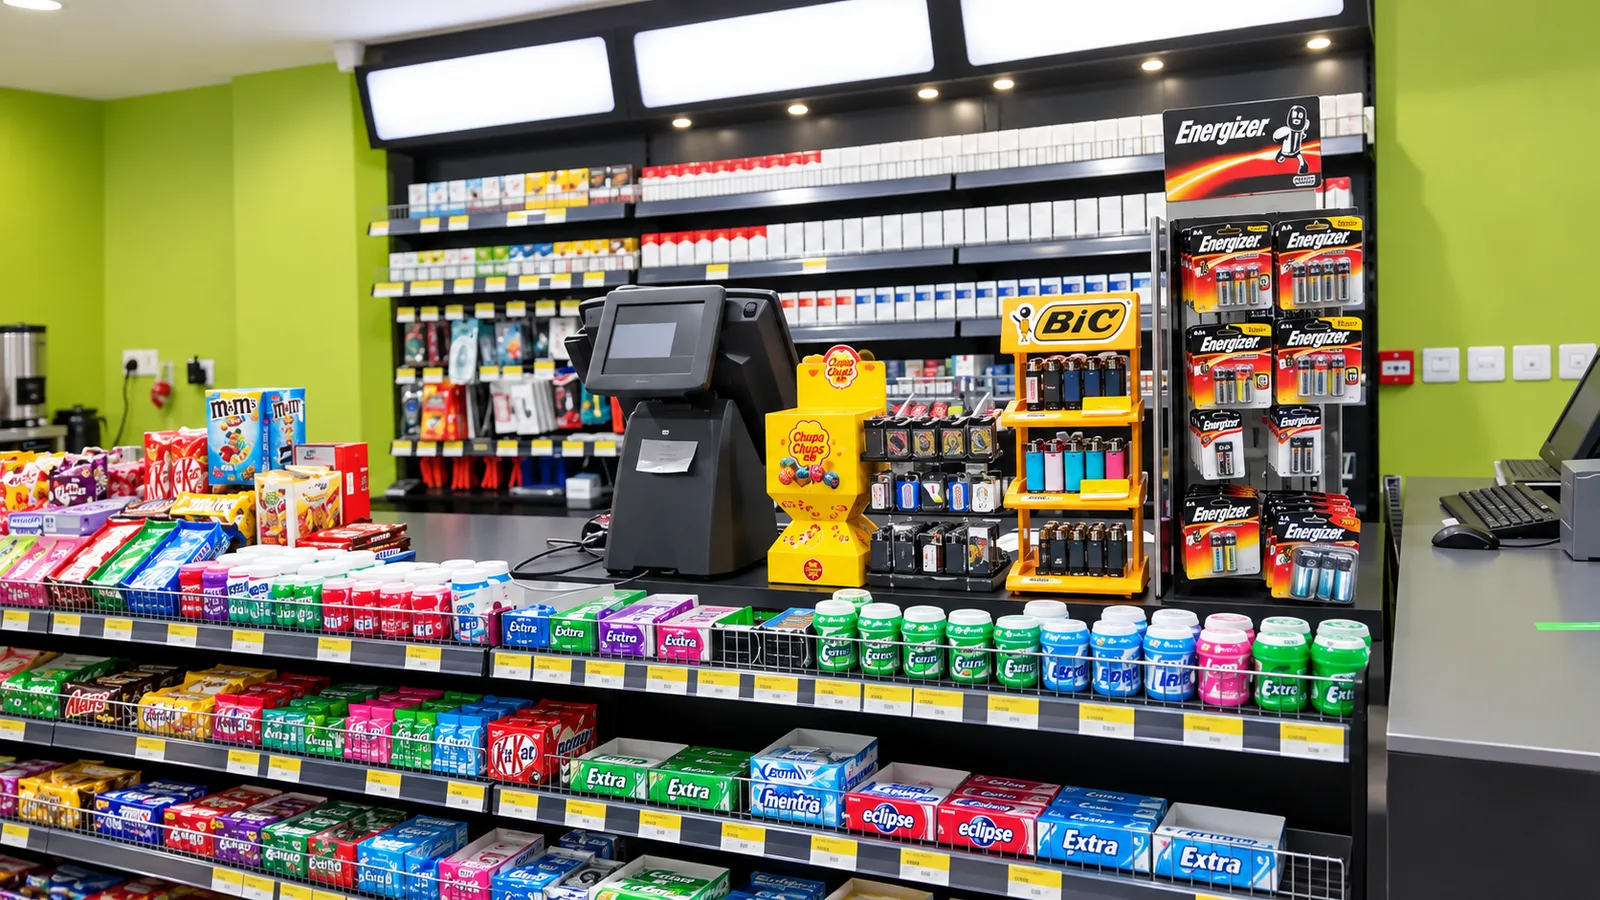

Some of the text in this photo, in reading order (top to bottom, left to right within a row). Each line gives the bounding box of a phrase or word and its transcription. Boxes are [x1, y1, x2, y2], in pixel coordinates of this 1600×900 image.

[1174, 115, 1270, 145] Energizer
[1199, 233, 1262, 254] Energizer
[1287, 229, 1350, 250] Energizer
[1200, 333, 1261, 353] Energizer
[1287, 329, 1350, 348] Energizer
[793, 432, 825, 444] Chupa
[792, 443, 825, 456] Chups
[1192, 503, 1251, 522] Energizer
[1285, 523, 1346, 542] Energizer
[586, 767, 627, 788] Extra
[667, 777, 711, 801] Extra
[862, 806, 915, 830] eclipse
[958, 818, 1014, 846] eclipse
[1062, 828, 1119, 856] Extra
[1179, 846, 1242, 875] Extra
